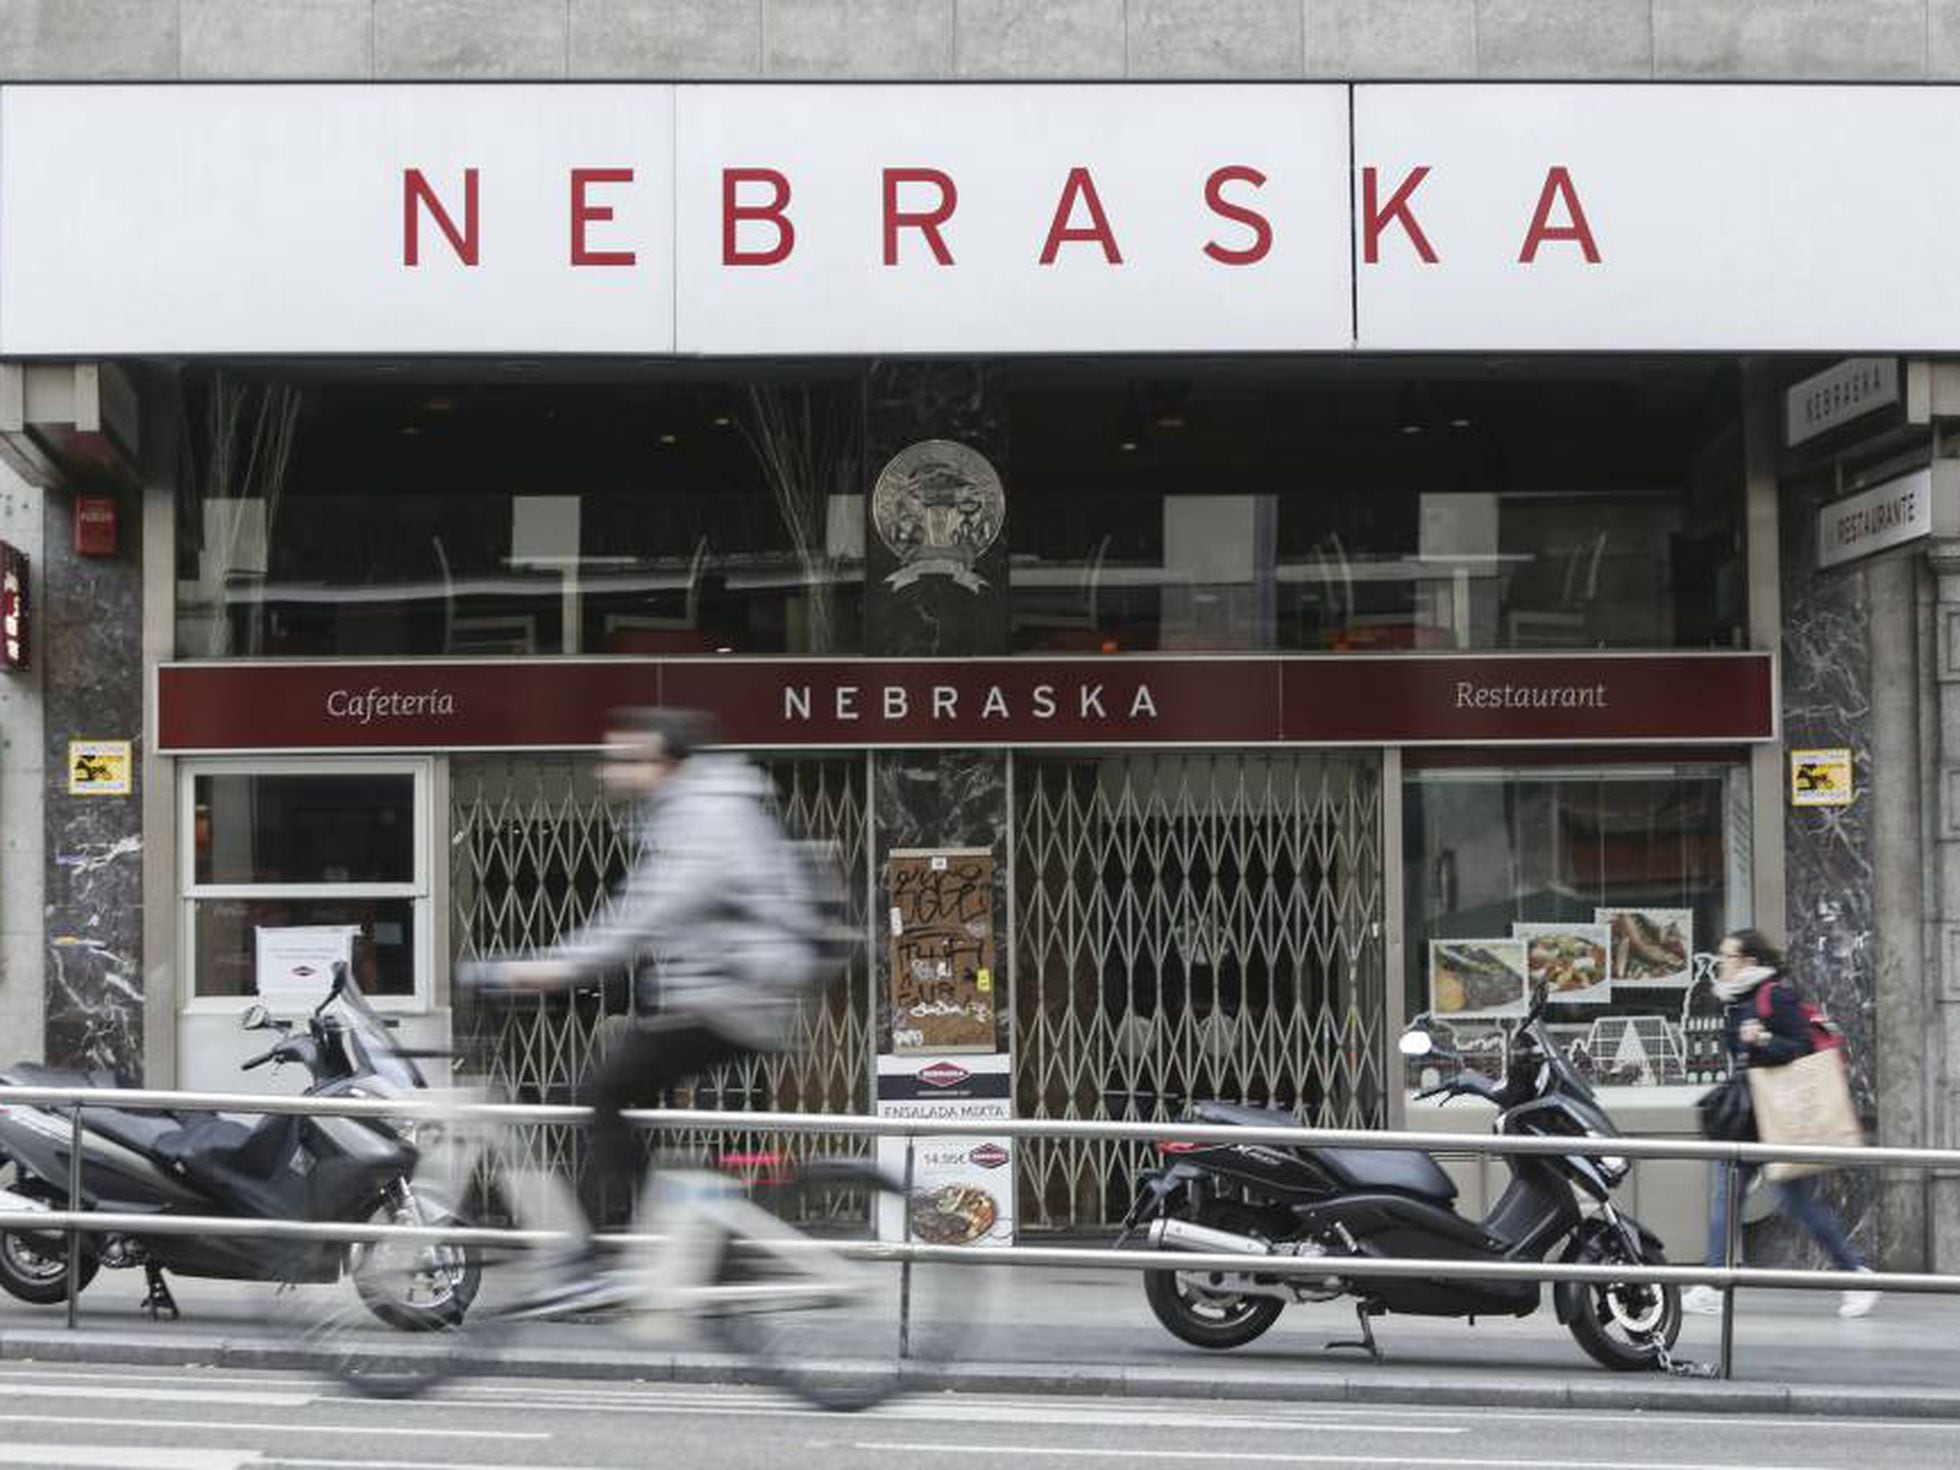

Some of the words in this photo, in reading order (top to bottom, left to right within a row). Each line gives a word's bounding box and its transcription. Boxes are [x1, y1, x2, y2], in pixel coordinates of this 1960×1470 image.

[404, 165, 1602, 267] NEBRASKA
[1837, 491, 1915, 546] RESTAURANTE
[784, 684, 1159, 720] NEBRASKA
[1455, 682, 1607, 708] Restaurant
[884, 1105, 958, 1119] ENSALADA
[960, 1104, 1005, 1118] MIXTA
